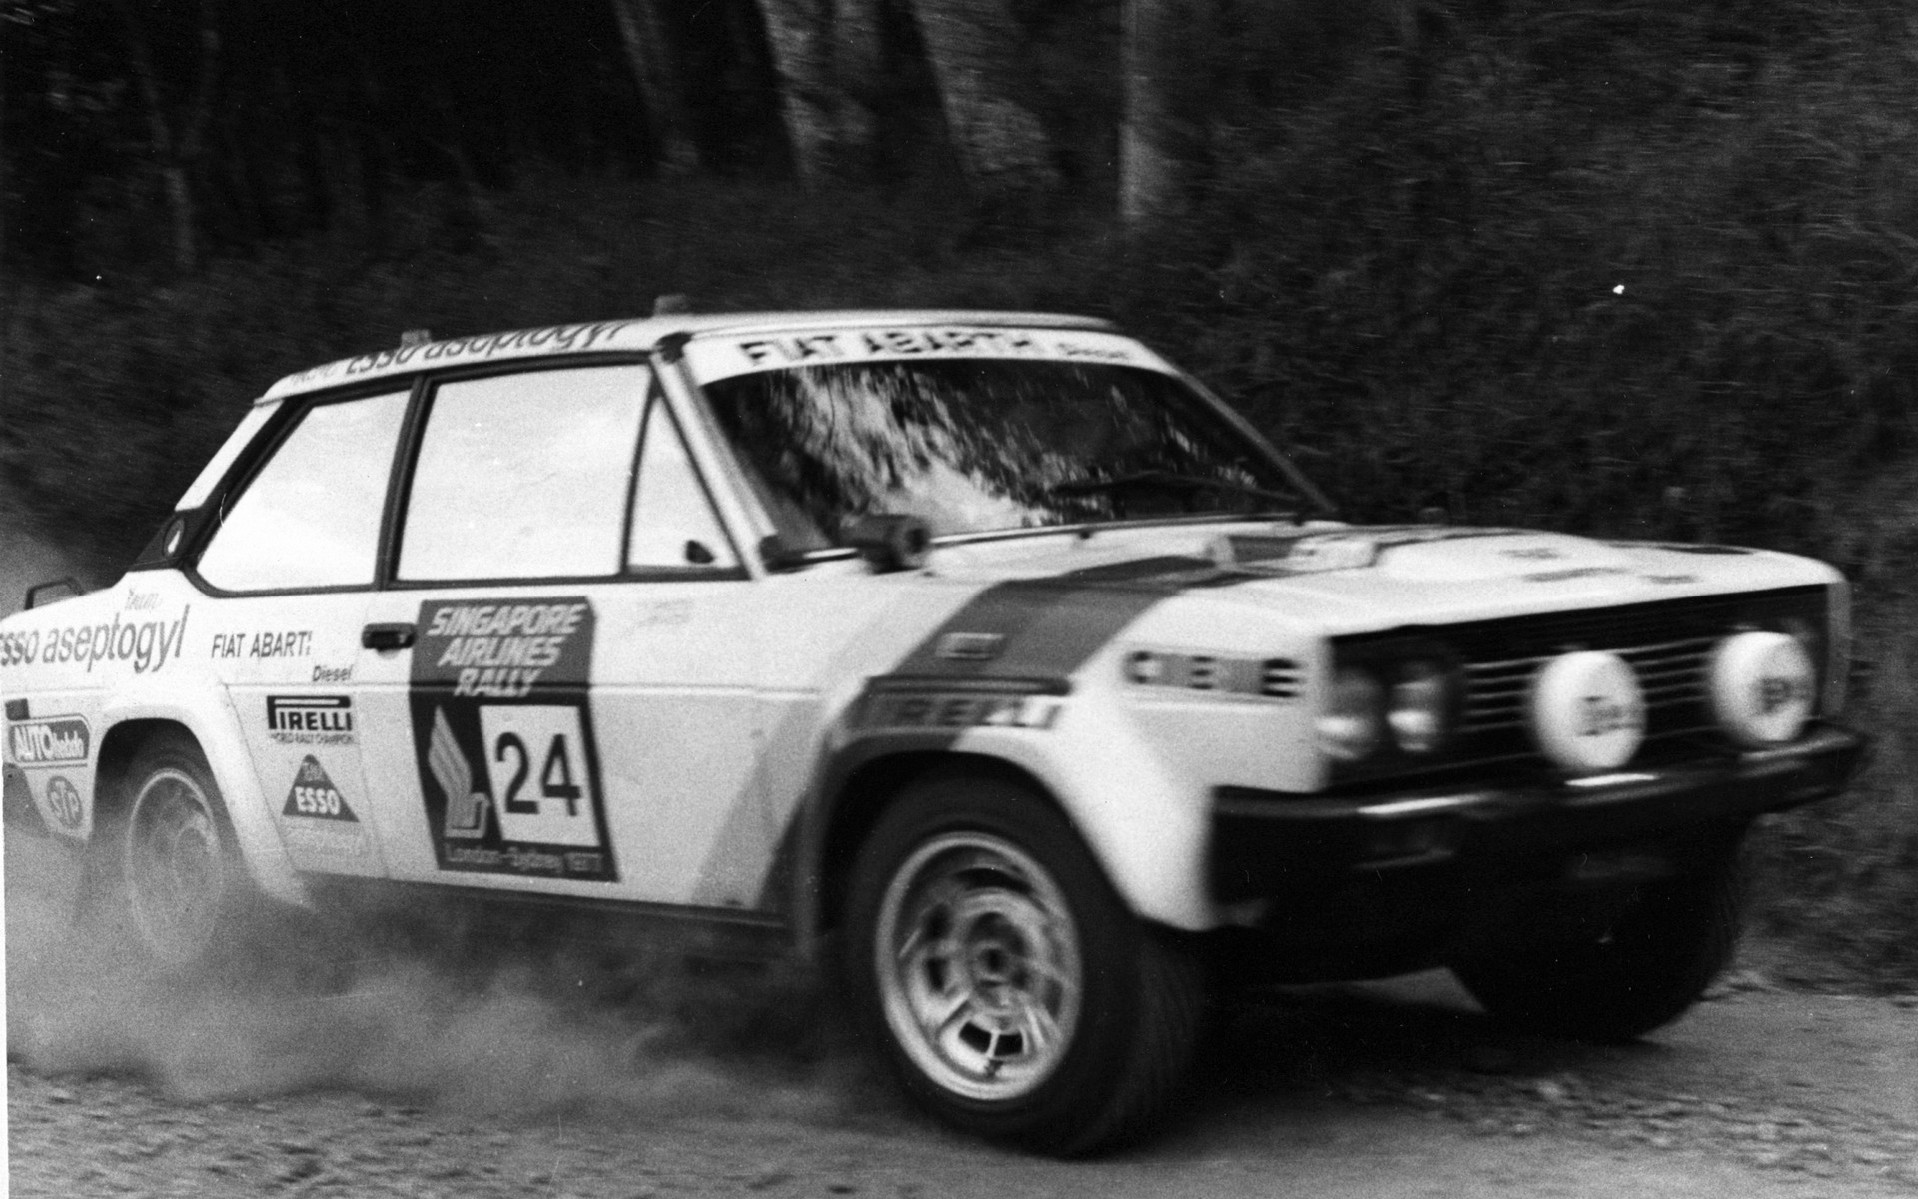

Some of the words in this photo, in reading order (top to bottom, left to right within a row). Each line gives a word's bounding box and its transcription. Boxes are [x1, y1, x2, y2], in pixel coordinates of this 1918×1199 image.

[426, 603, 588, 636] SINGAPORE
[42, 604, 190, 674] aseptogyl
[211, 633, 246, 659] FIAT
[437, 636, 566, 667] AIRLINES
[312, 664, 353, 682] Diesel
[454, 667, 544, 697] RALLY
[267, 695, 353, 731] PIRELLI
[495, 732, 582, 817] 24
[294, 786, 341, 815] ESSO
